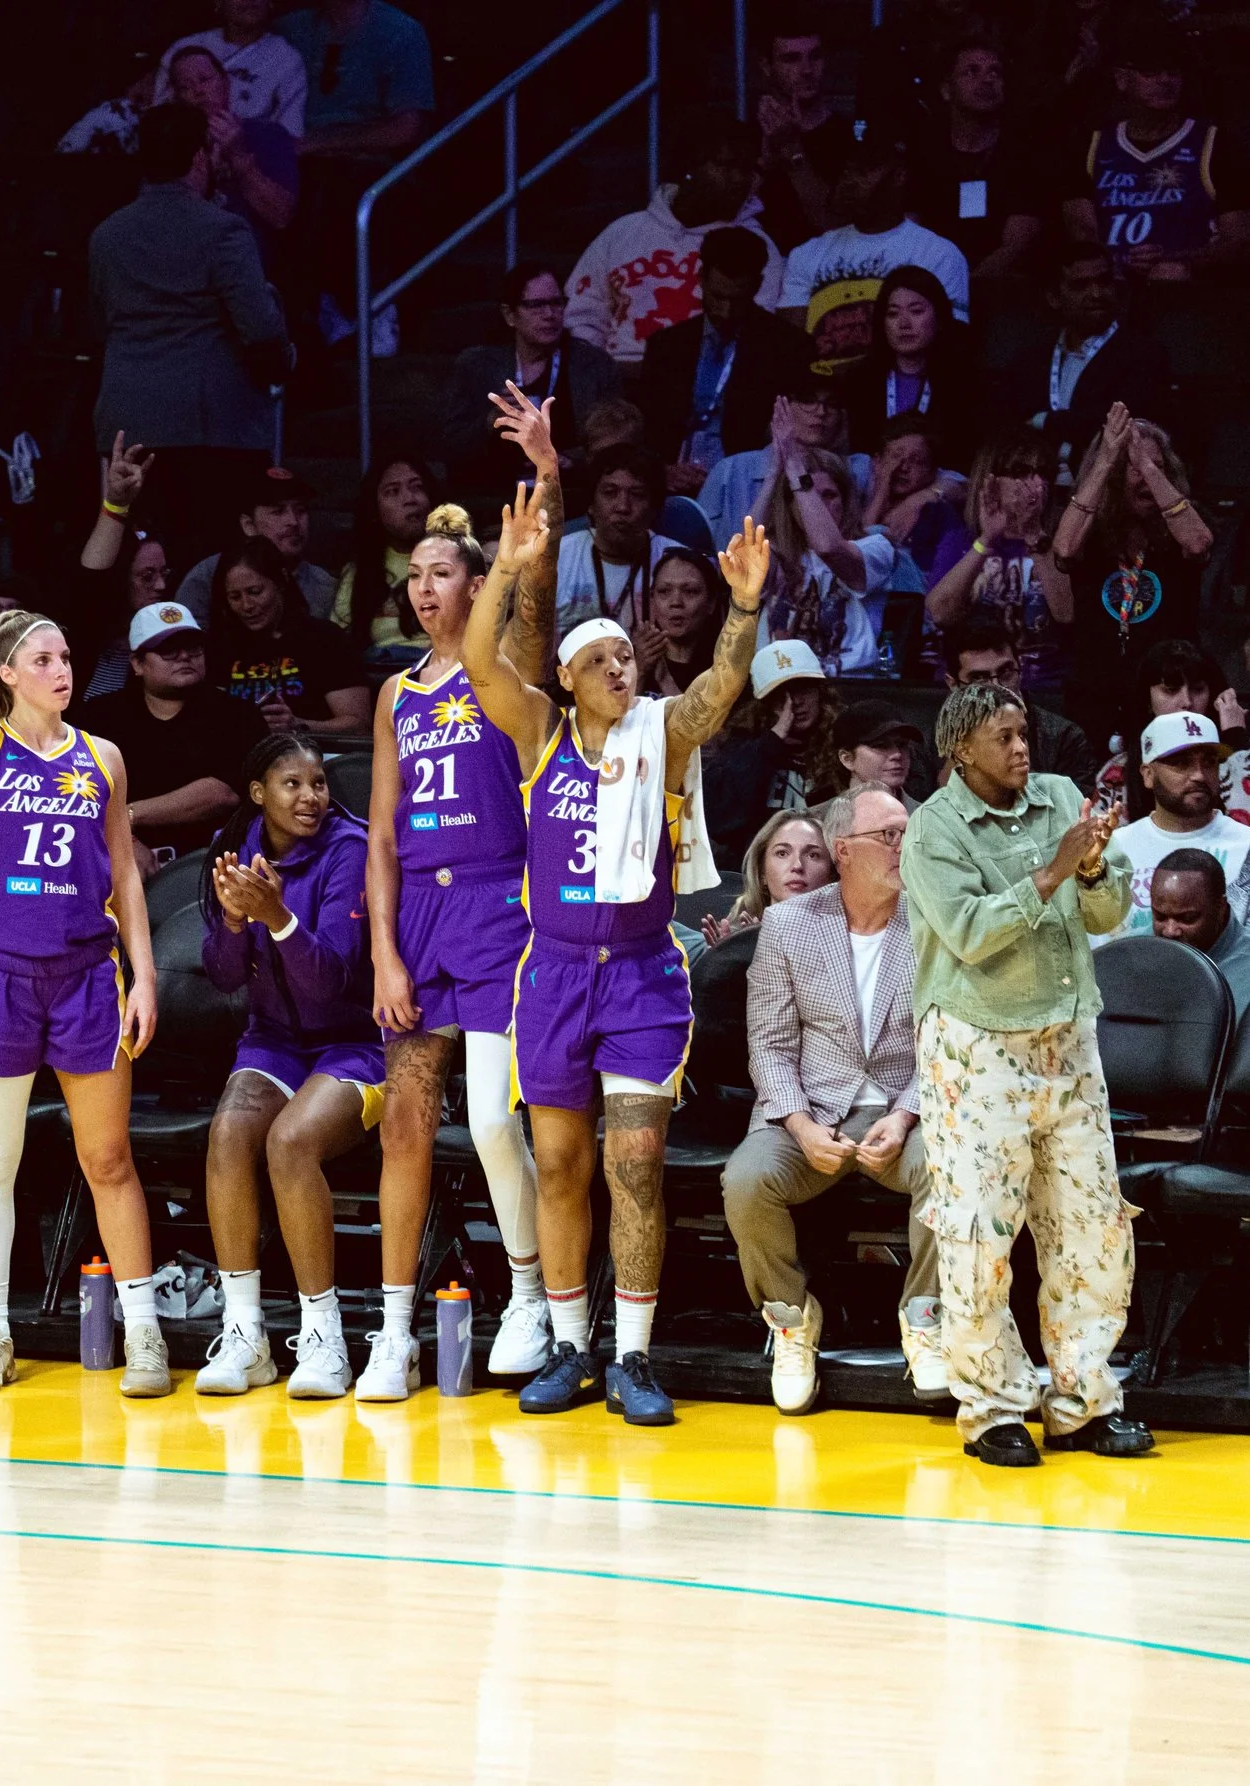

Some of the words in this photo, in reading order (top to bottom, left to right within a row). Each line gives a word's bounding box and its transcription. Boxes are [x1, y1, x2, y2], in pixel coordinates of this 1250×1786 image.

[1097, 170, 1138, 190] LOS
[1106, 211, 1153, 247] 10
[774, 650, 792, 670] LA
[397, 713, 421, 743] LOS
[1183, 716, 1203, 736] LA
[398, 724, 483, 762] ANGELES
[73, 759, 95, 768] Albert
[411, 753, 460, 804] 21
[547, 771, 592, 799] LOS
[413, 817, 435, 828] UCLA
[439, 812, 478, 827] Health
[16, 822, 76, 868] 13
[10, 881, 38, 892] UCLA
[43, 881, 79, 896] Health
[564, 889, 591, 901] UCLA
